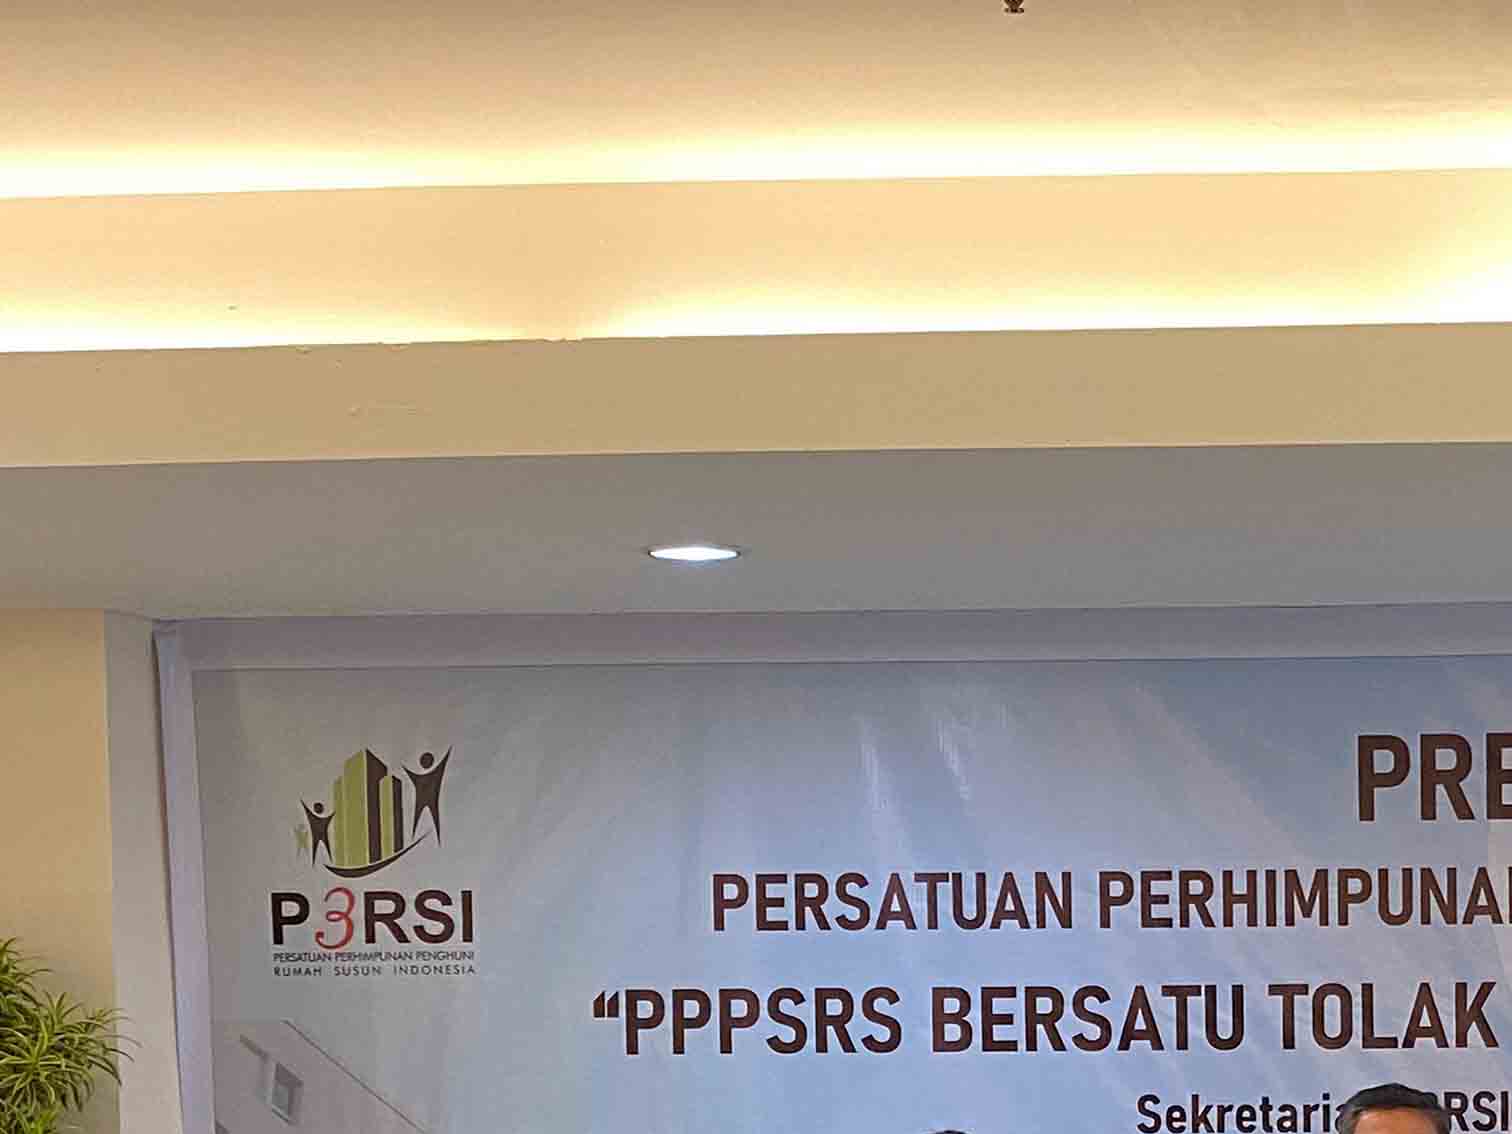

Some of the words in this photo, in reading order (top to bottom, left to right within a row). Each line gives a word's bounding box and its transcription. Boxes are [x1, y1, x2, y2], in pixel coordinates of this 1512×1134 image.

[271, 887, 474, 949] P3RSI
[712, 871, 1073, 932] PERSATUAN
[273, 951, 332, 962] PERSATUAN
[334, 951, 413, 962] PERHIMPUNAN
[415, 950, 475, 961] PENGHUNI
[273, 966, 322, 977] RUMAH
[333, 965, 381, 977] SUSUN
[393, 964, 476, 976] INDONESIA
[931, 983, 1245, 1053] BERSATU
[1267, 981, 1500, 1050] TOLAK
[1136, 1092, 1346, 1134] Sekretari
